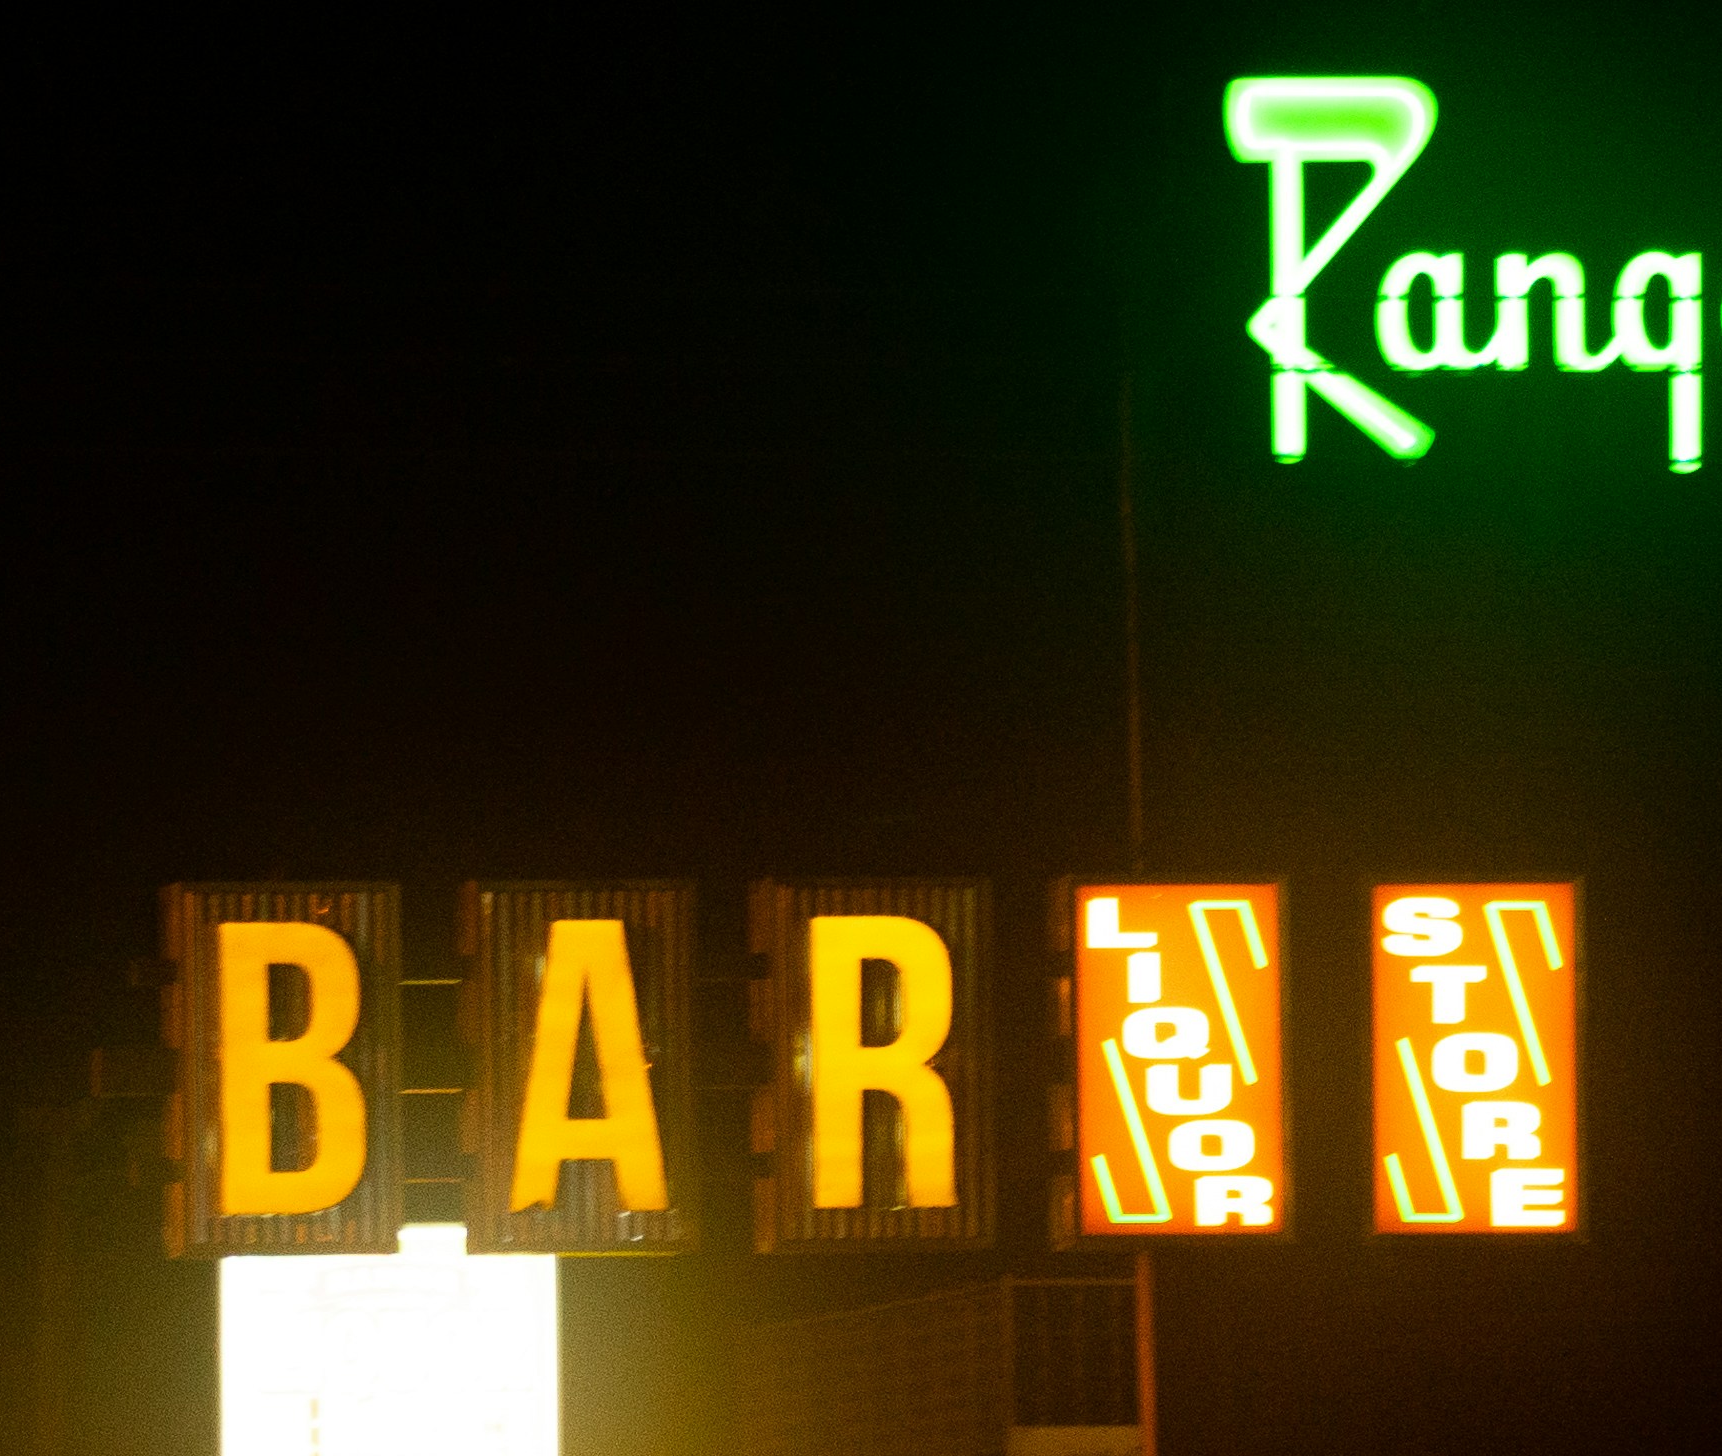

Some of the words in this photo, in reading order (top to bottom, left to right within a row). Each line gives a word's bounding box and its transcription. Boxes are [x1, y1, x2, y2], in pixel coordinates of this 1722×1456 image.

[218, 915, 959, 1217] BAR
[1084, 896, 1275, 1228] LIQUOR
[1380, 895, 1567, 1228] STORE
